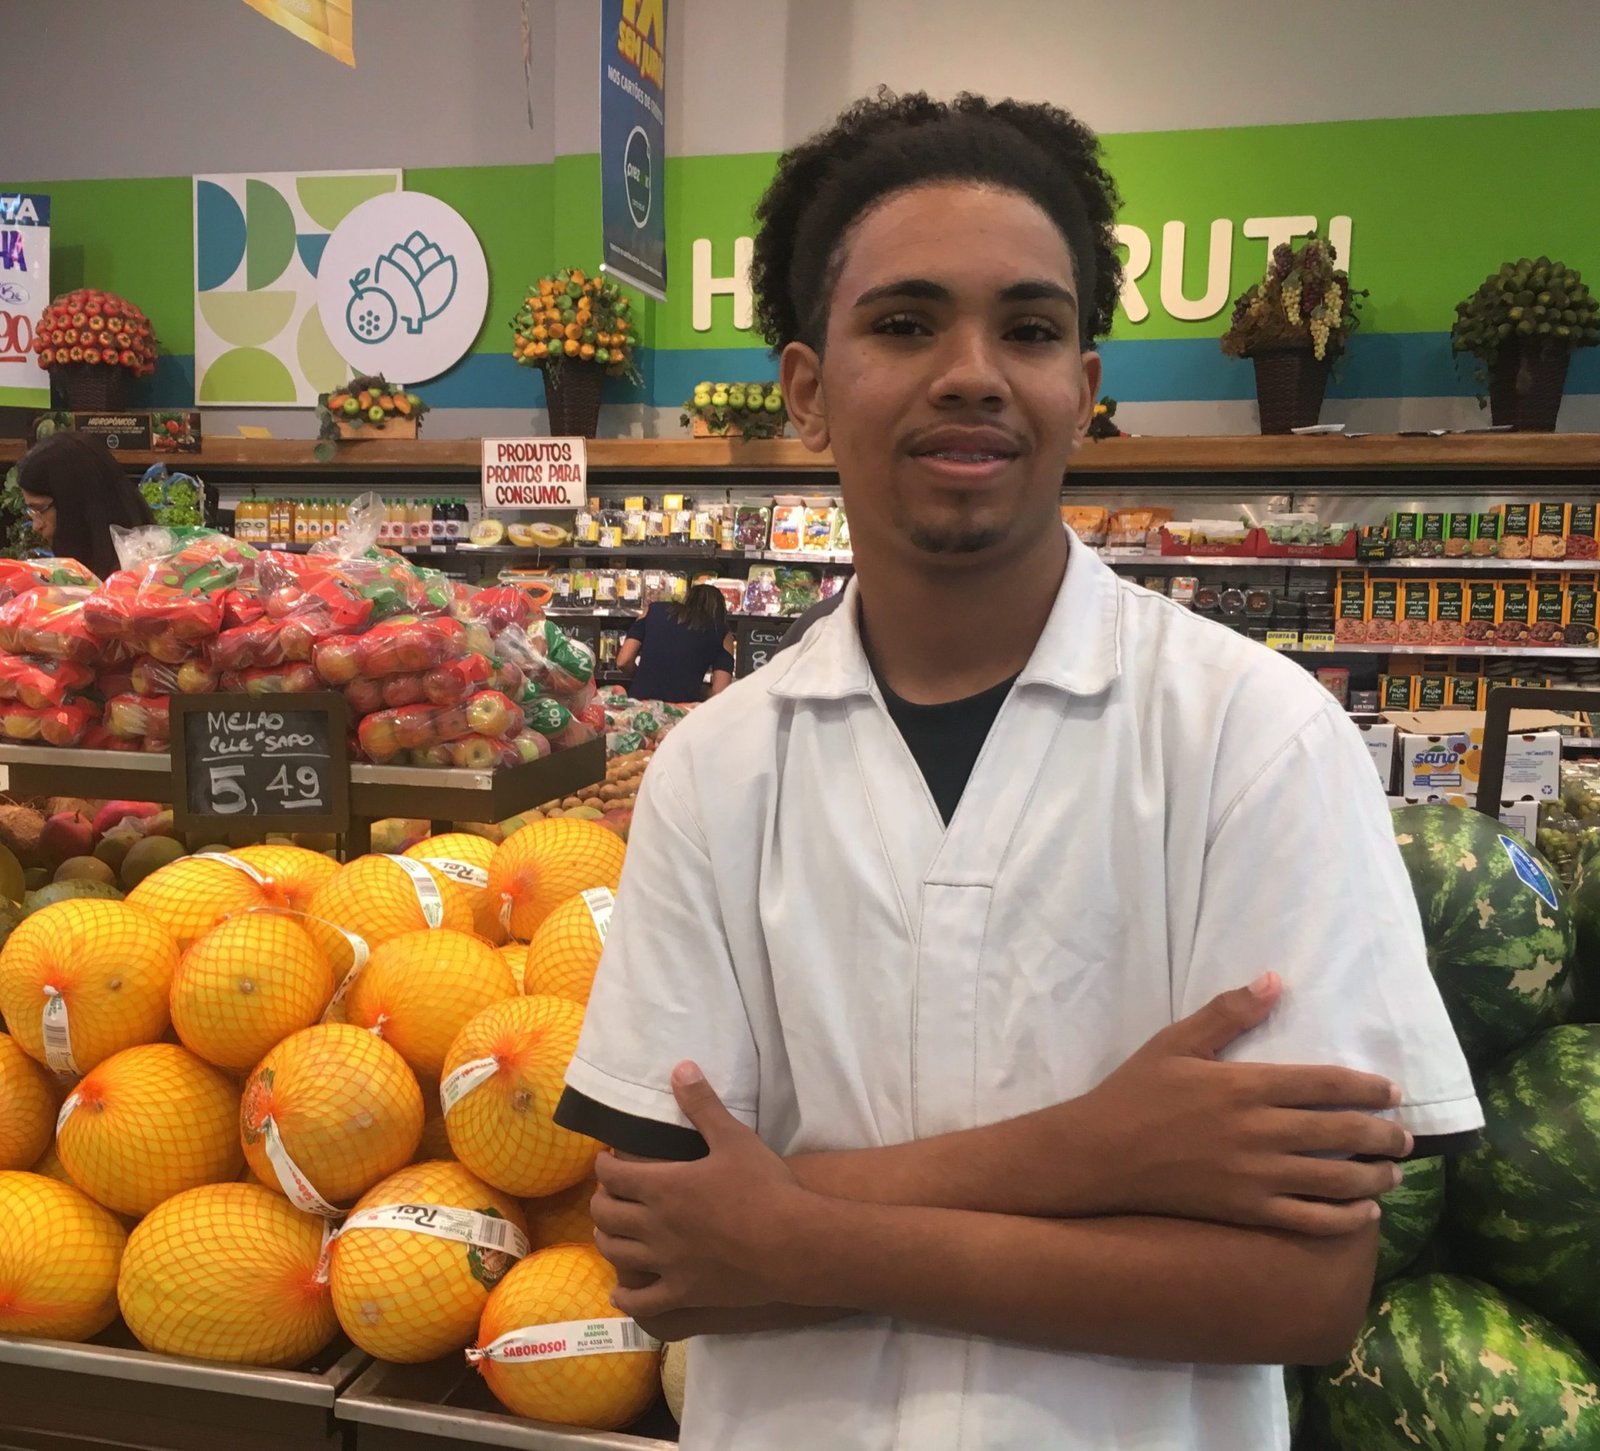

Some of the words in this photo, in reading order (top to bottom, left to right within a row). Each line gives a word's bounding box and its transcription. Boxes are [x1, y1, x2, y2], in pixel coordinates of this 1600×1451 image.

[607, 64, 621, 86] NOS
[497, 442, 572, 462] PRODUTOS
[486, 464, 543, 484] PRONTOS
[548, 464, 581, 482] PARA
[496, 485, 571, 505] CONSUMO.
[264, 733, 316, 752] SAPO
[503, 1339, 567, 1358] SABOROSO!
